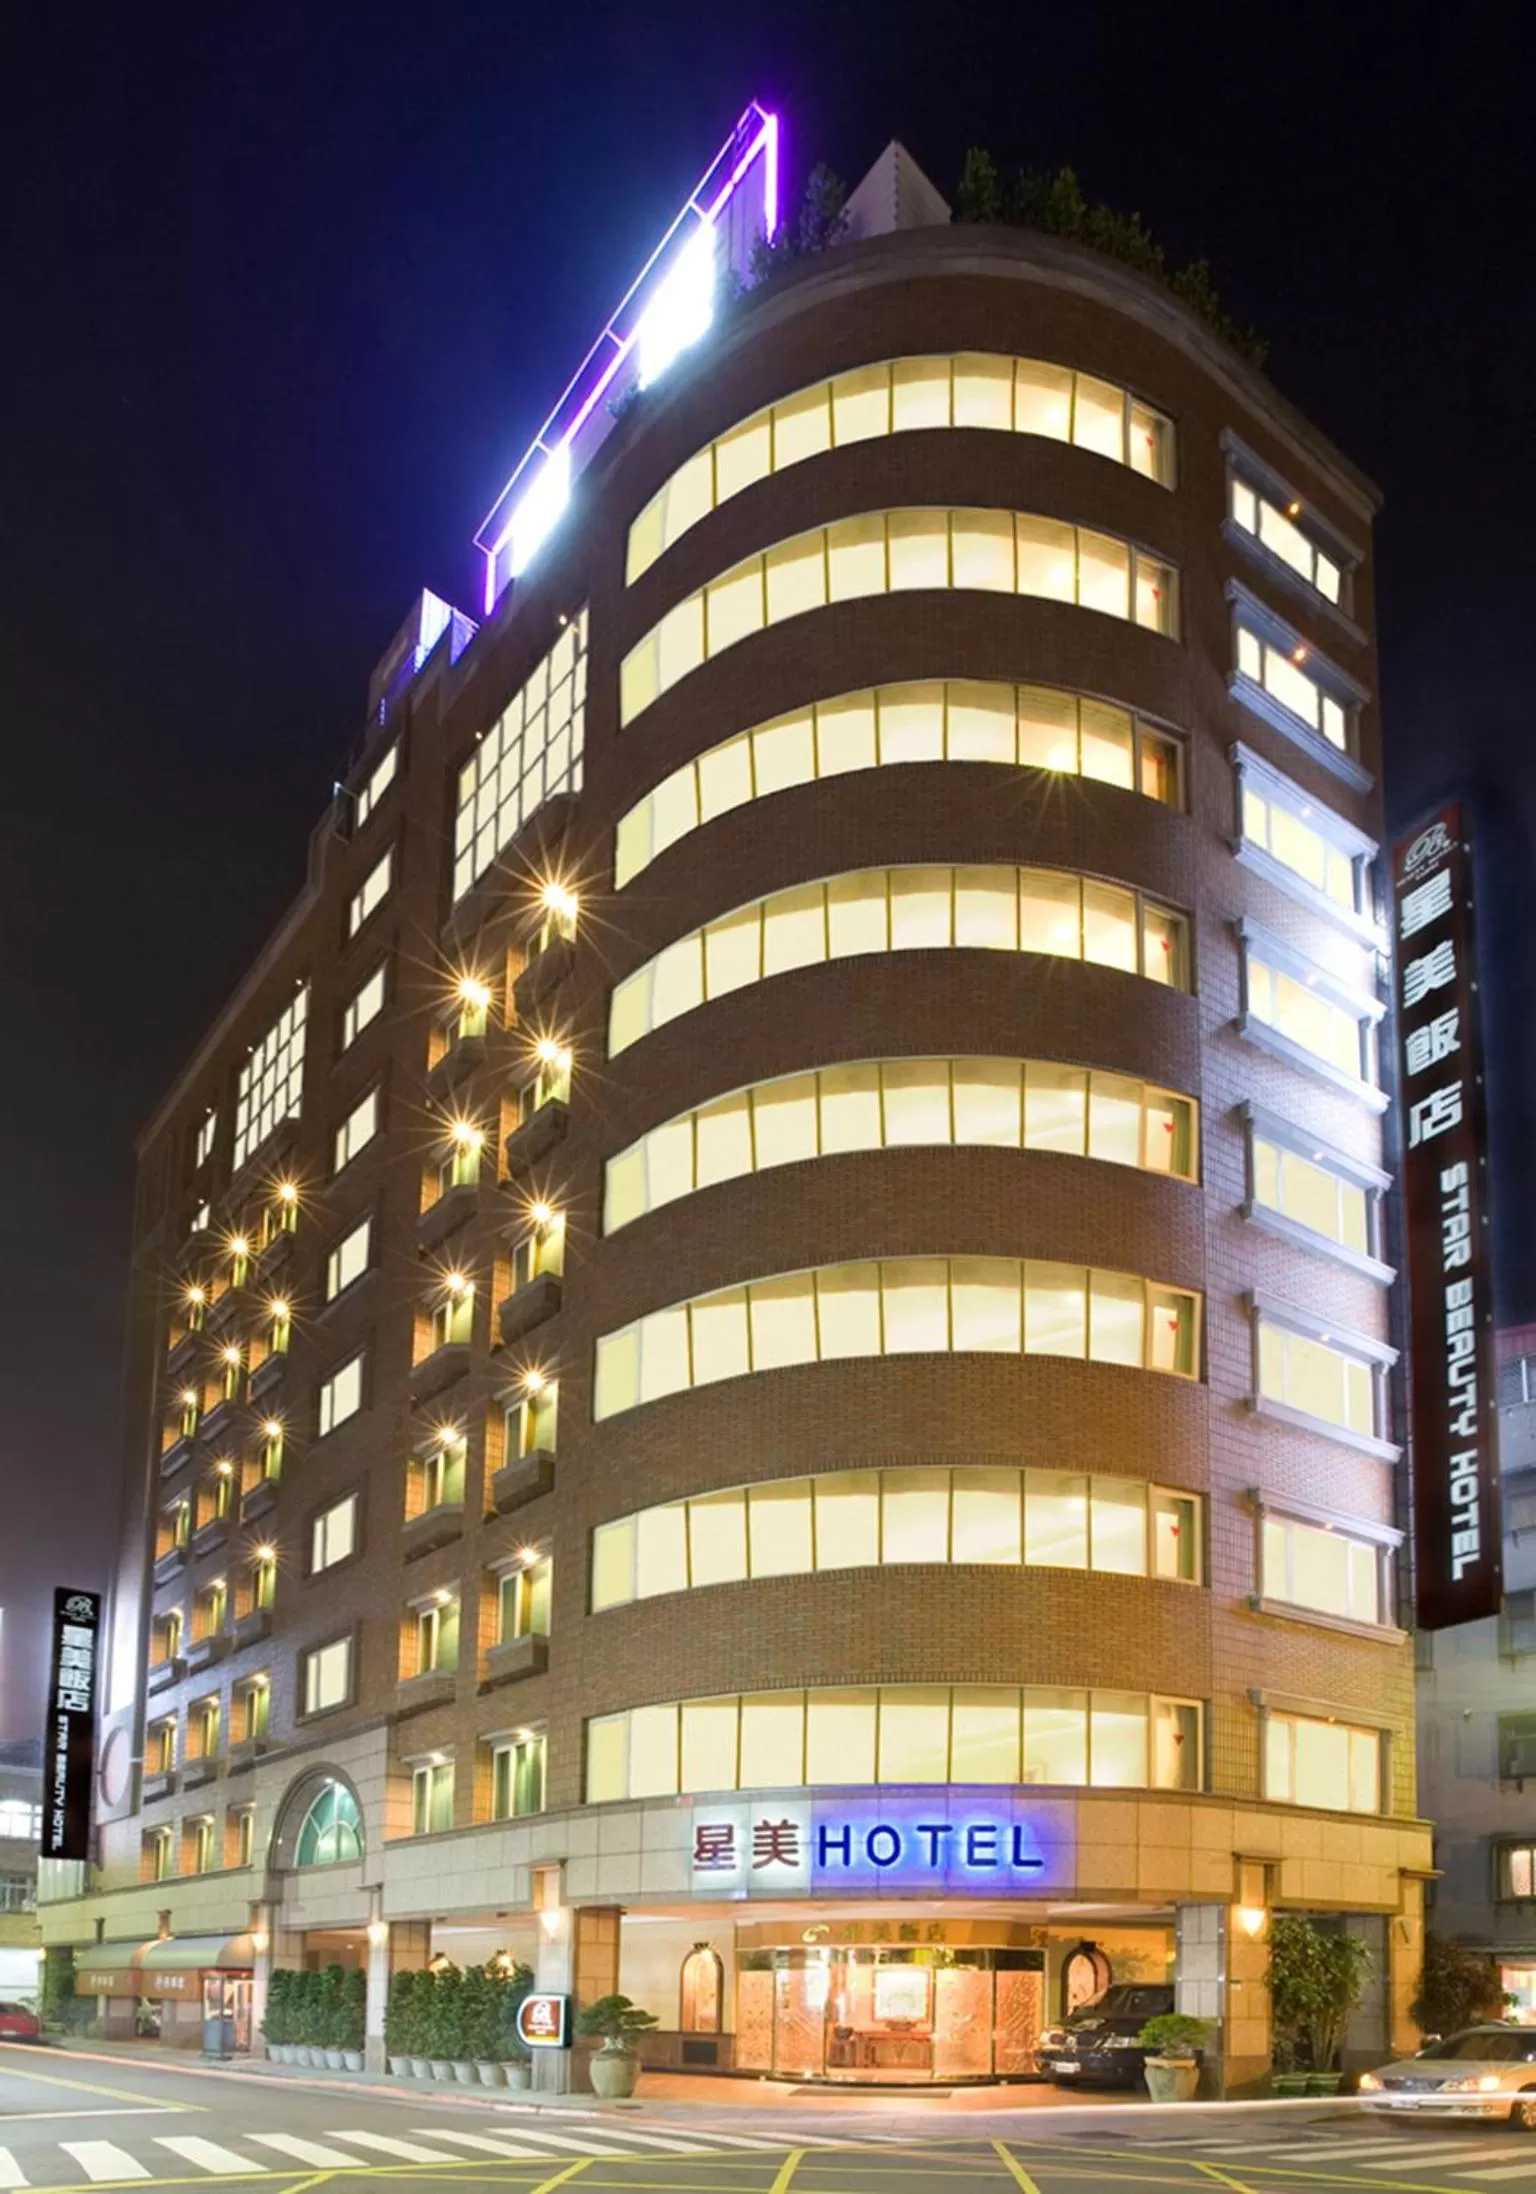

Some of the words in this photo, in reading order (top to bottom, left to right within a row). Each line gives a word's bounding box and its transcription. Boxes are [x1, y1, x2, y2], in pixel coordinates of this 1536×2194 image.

[1400, 868, 1462, 1149] 星美飯店
[1441, 1161, 1471, 1272] STAR
[1446, 1276, 1477, 1437] BEAUTY
[1450, 1448, 1480, 1581] HOTEL
[693, 1819, 799, 1871] 星美
[818, 1825, 1044, 1868] HOTEL
